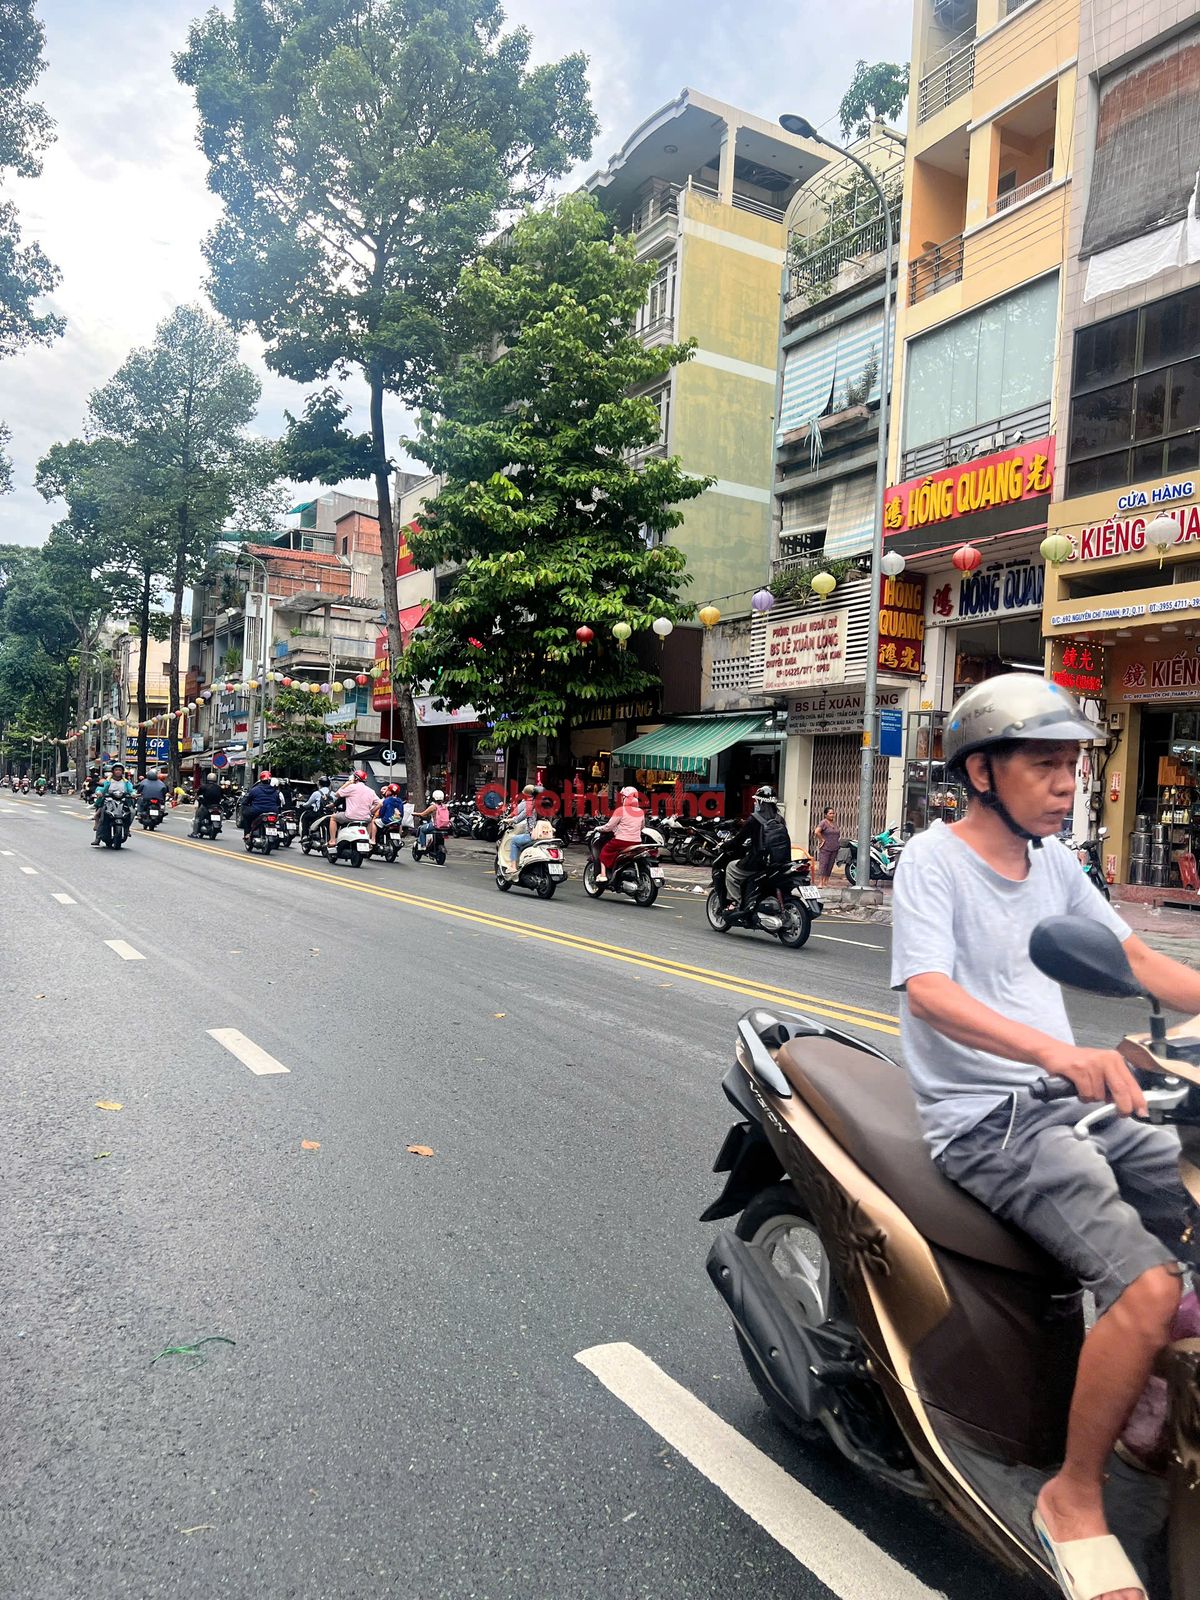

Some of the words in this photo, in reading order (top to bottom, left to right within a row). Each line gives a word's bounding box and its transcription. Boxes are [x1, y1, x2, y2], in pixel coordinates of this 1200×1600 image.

[1026, 453, 1051, 491] 光
[908, 476, 954, 527] HỒNG
[957, 457, 1024, 514] QUANG
[1118, 491, 1147, 510] CỬA
[1151, 482, 1194, 503] HÀNG
[1081, 514, 1146, 560] KIẾNG
[1160, 601, 1173, 610] 3955
[1174, 600, 1187, 608] 4711
[879, 609, 925, 640] QUANG
[817, 633, 838, 649] LONG
[795, 702, 809, 712] BS
[829, 695, 861, 710] XUÂN
